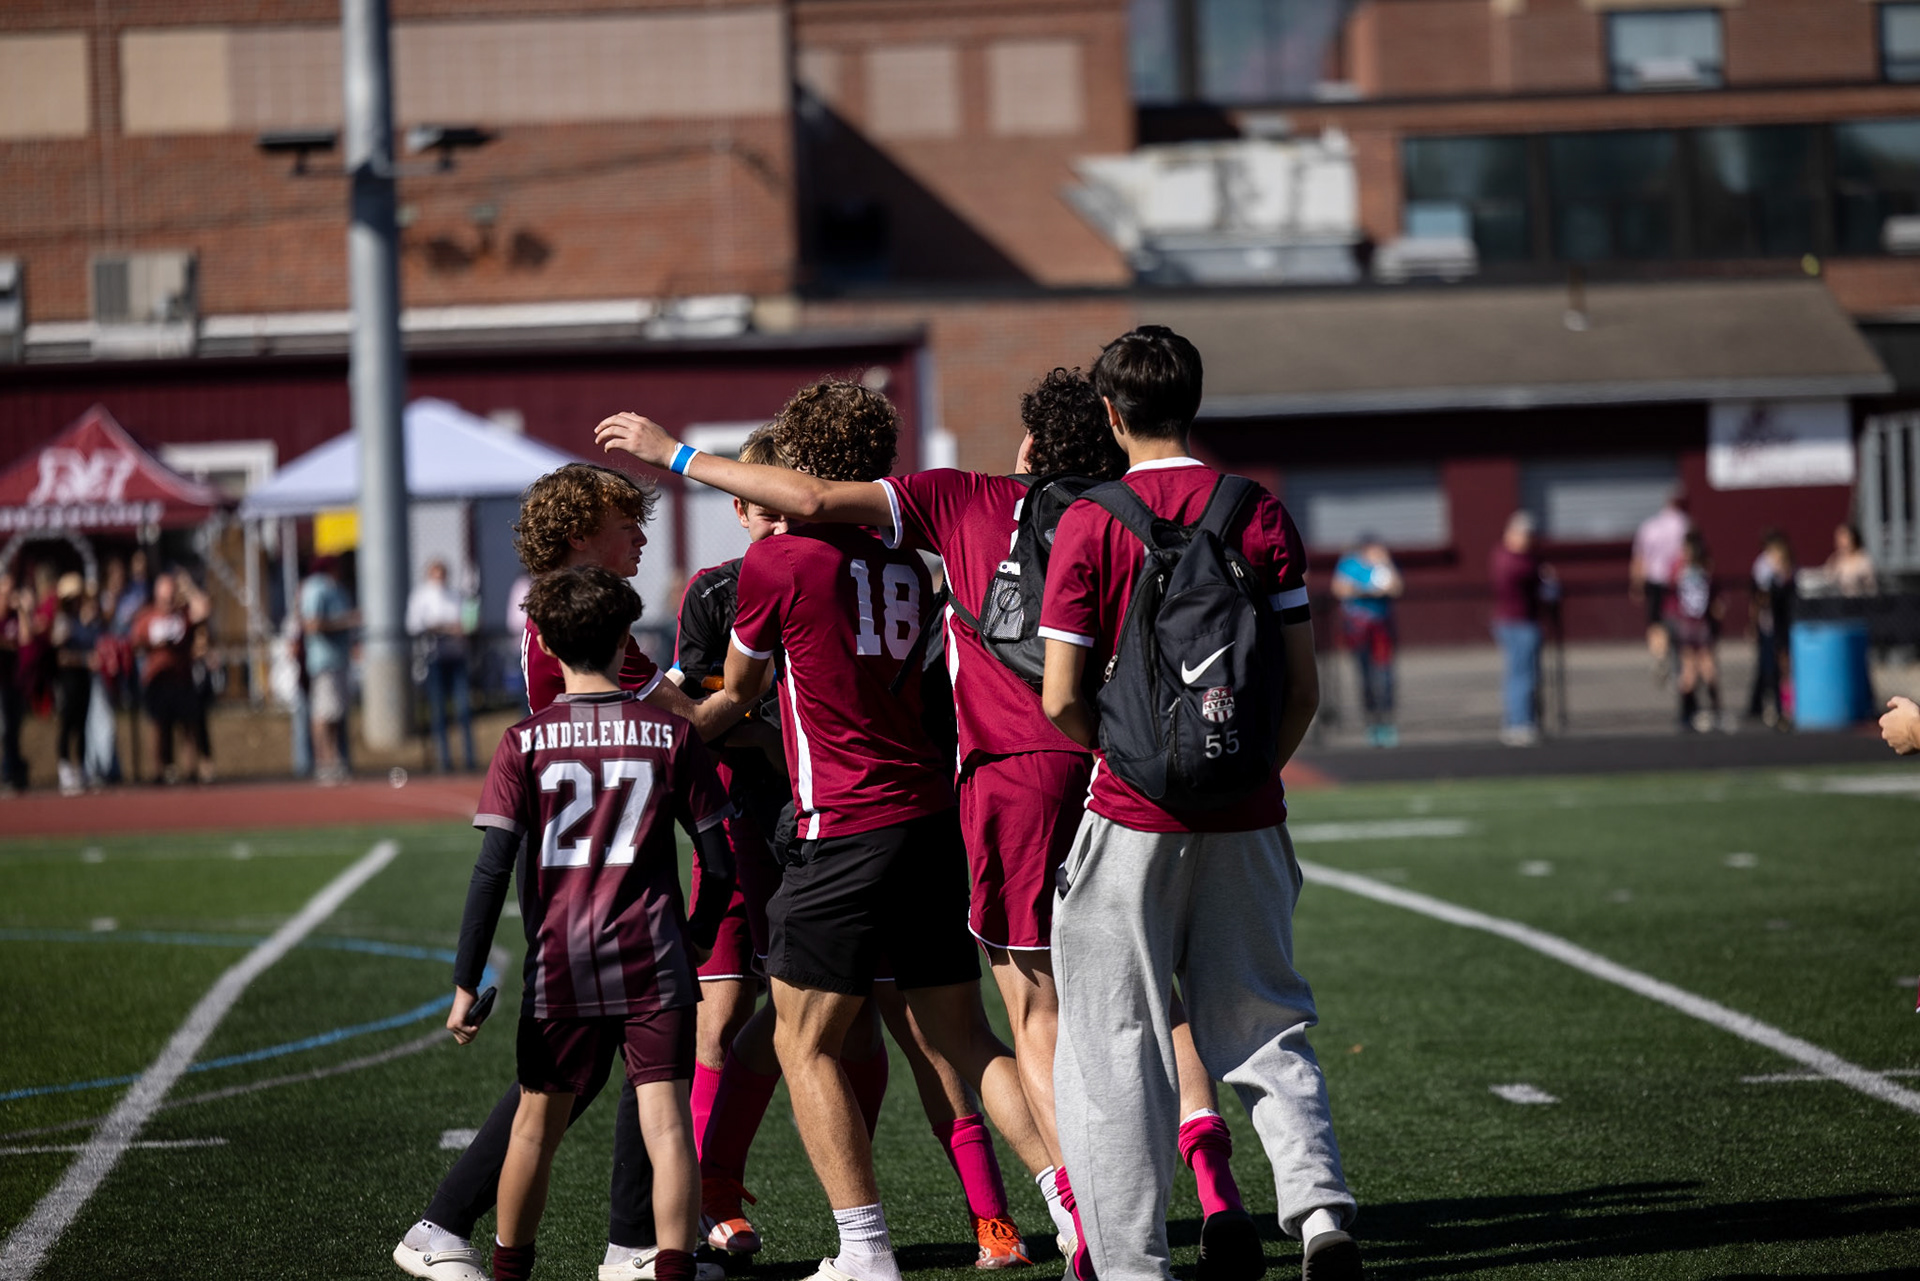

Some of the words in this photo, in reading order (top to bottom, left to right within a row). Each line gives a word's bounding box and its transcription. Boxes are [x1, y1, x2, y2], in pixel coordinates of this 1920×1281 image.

[849, 558, 920, 660] 18
[519, 719, 673, 754] MANDELENAKIS
[1205, 730, 1239, 759] 55
[538, 757, 655, 870] 27
